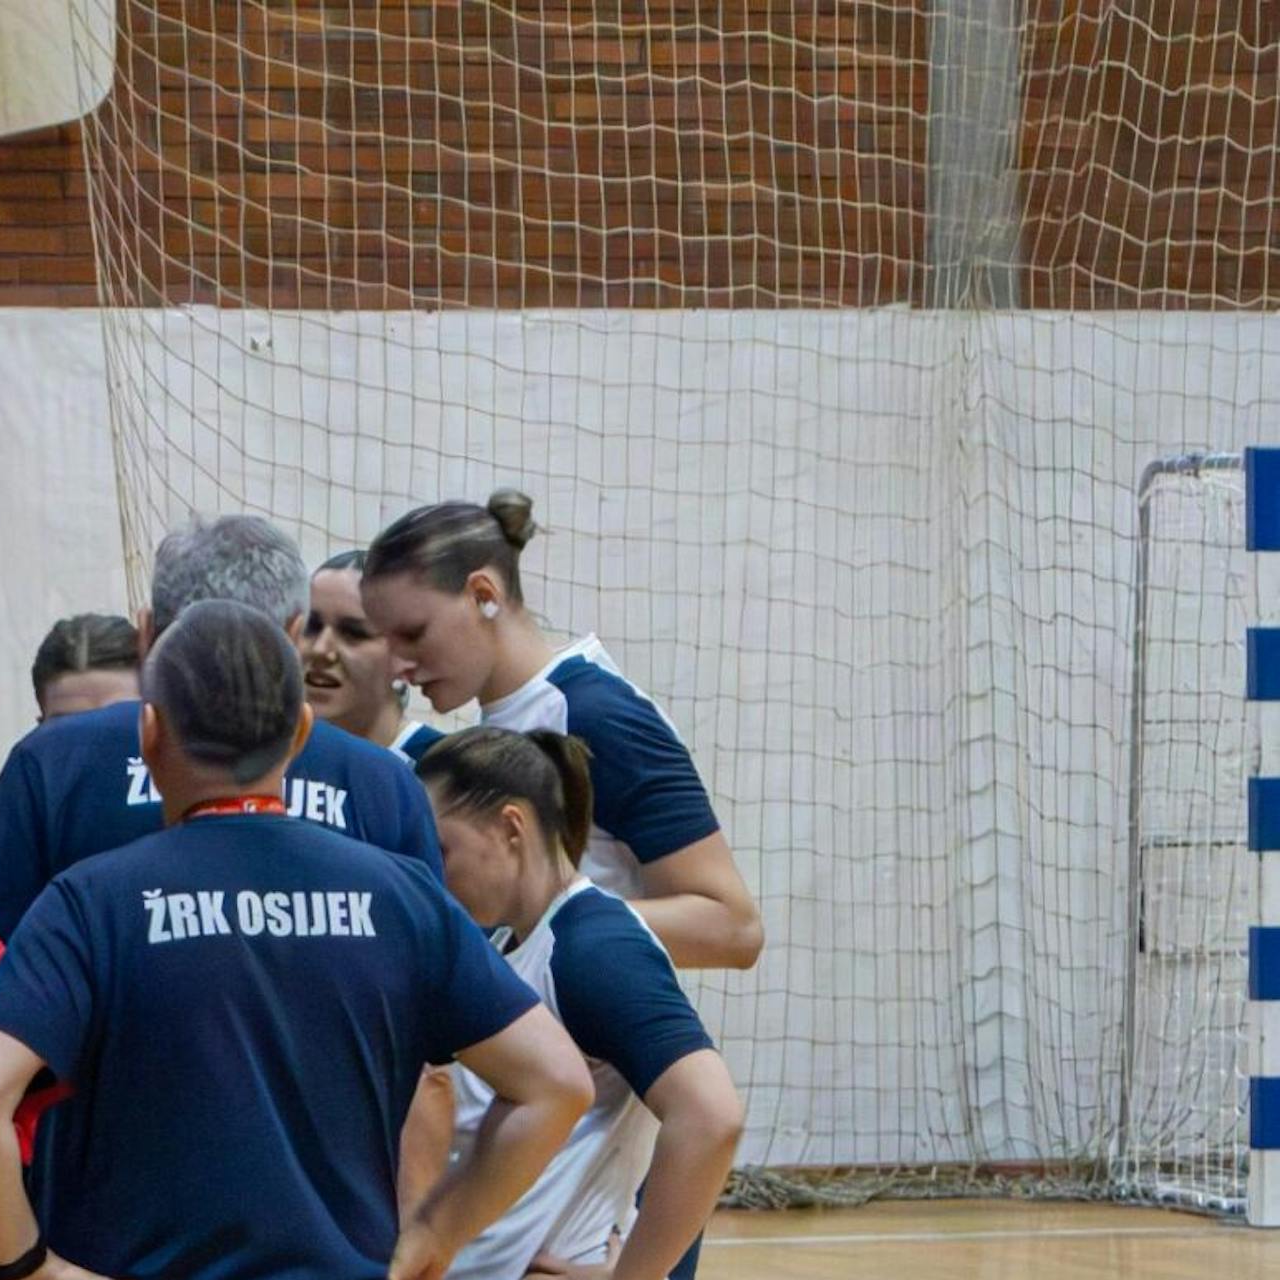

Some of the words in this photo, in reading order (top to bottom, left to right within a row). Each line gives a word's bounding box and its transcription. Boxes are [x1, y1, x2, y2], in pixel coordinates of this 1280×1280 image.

[281, 776, 348, 829] JEK
[142, 888, 231, 944] ŽRK
[236, 890, 376, 937] OSIJEK
